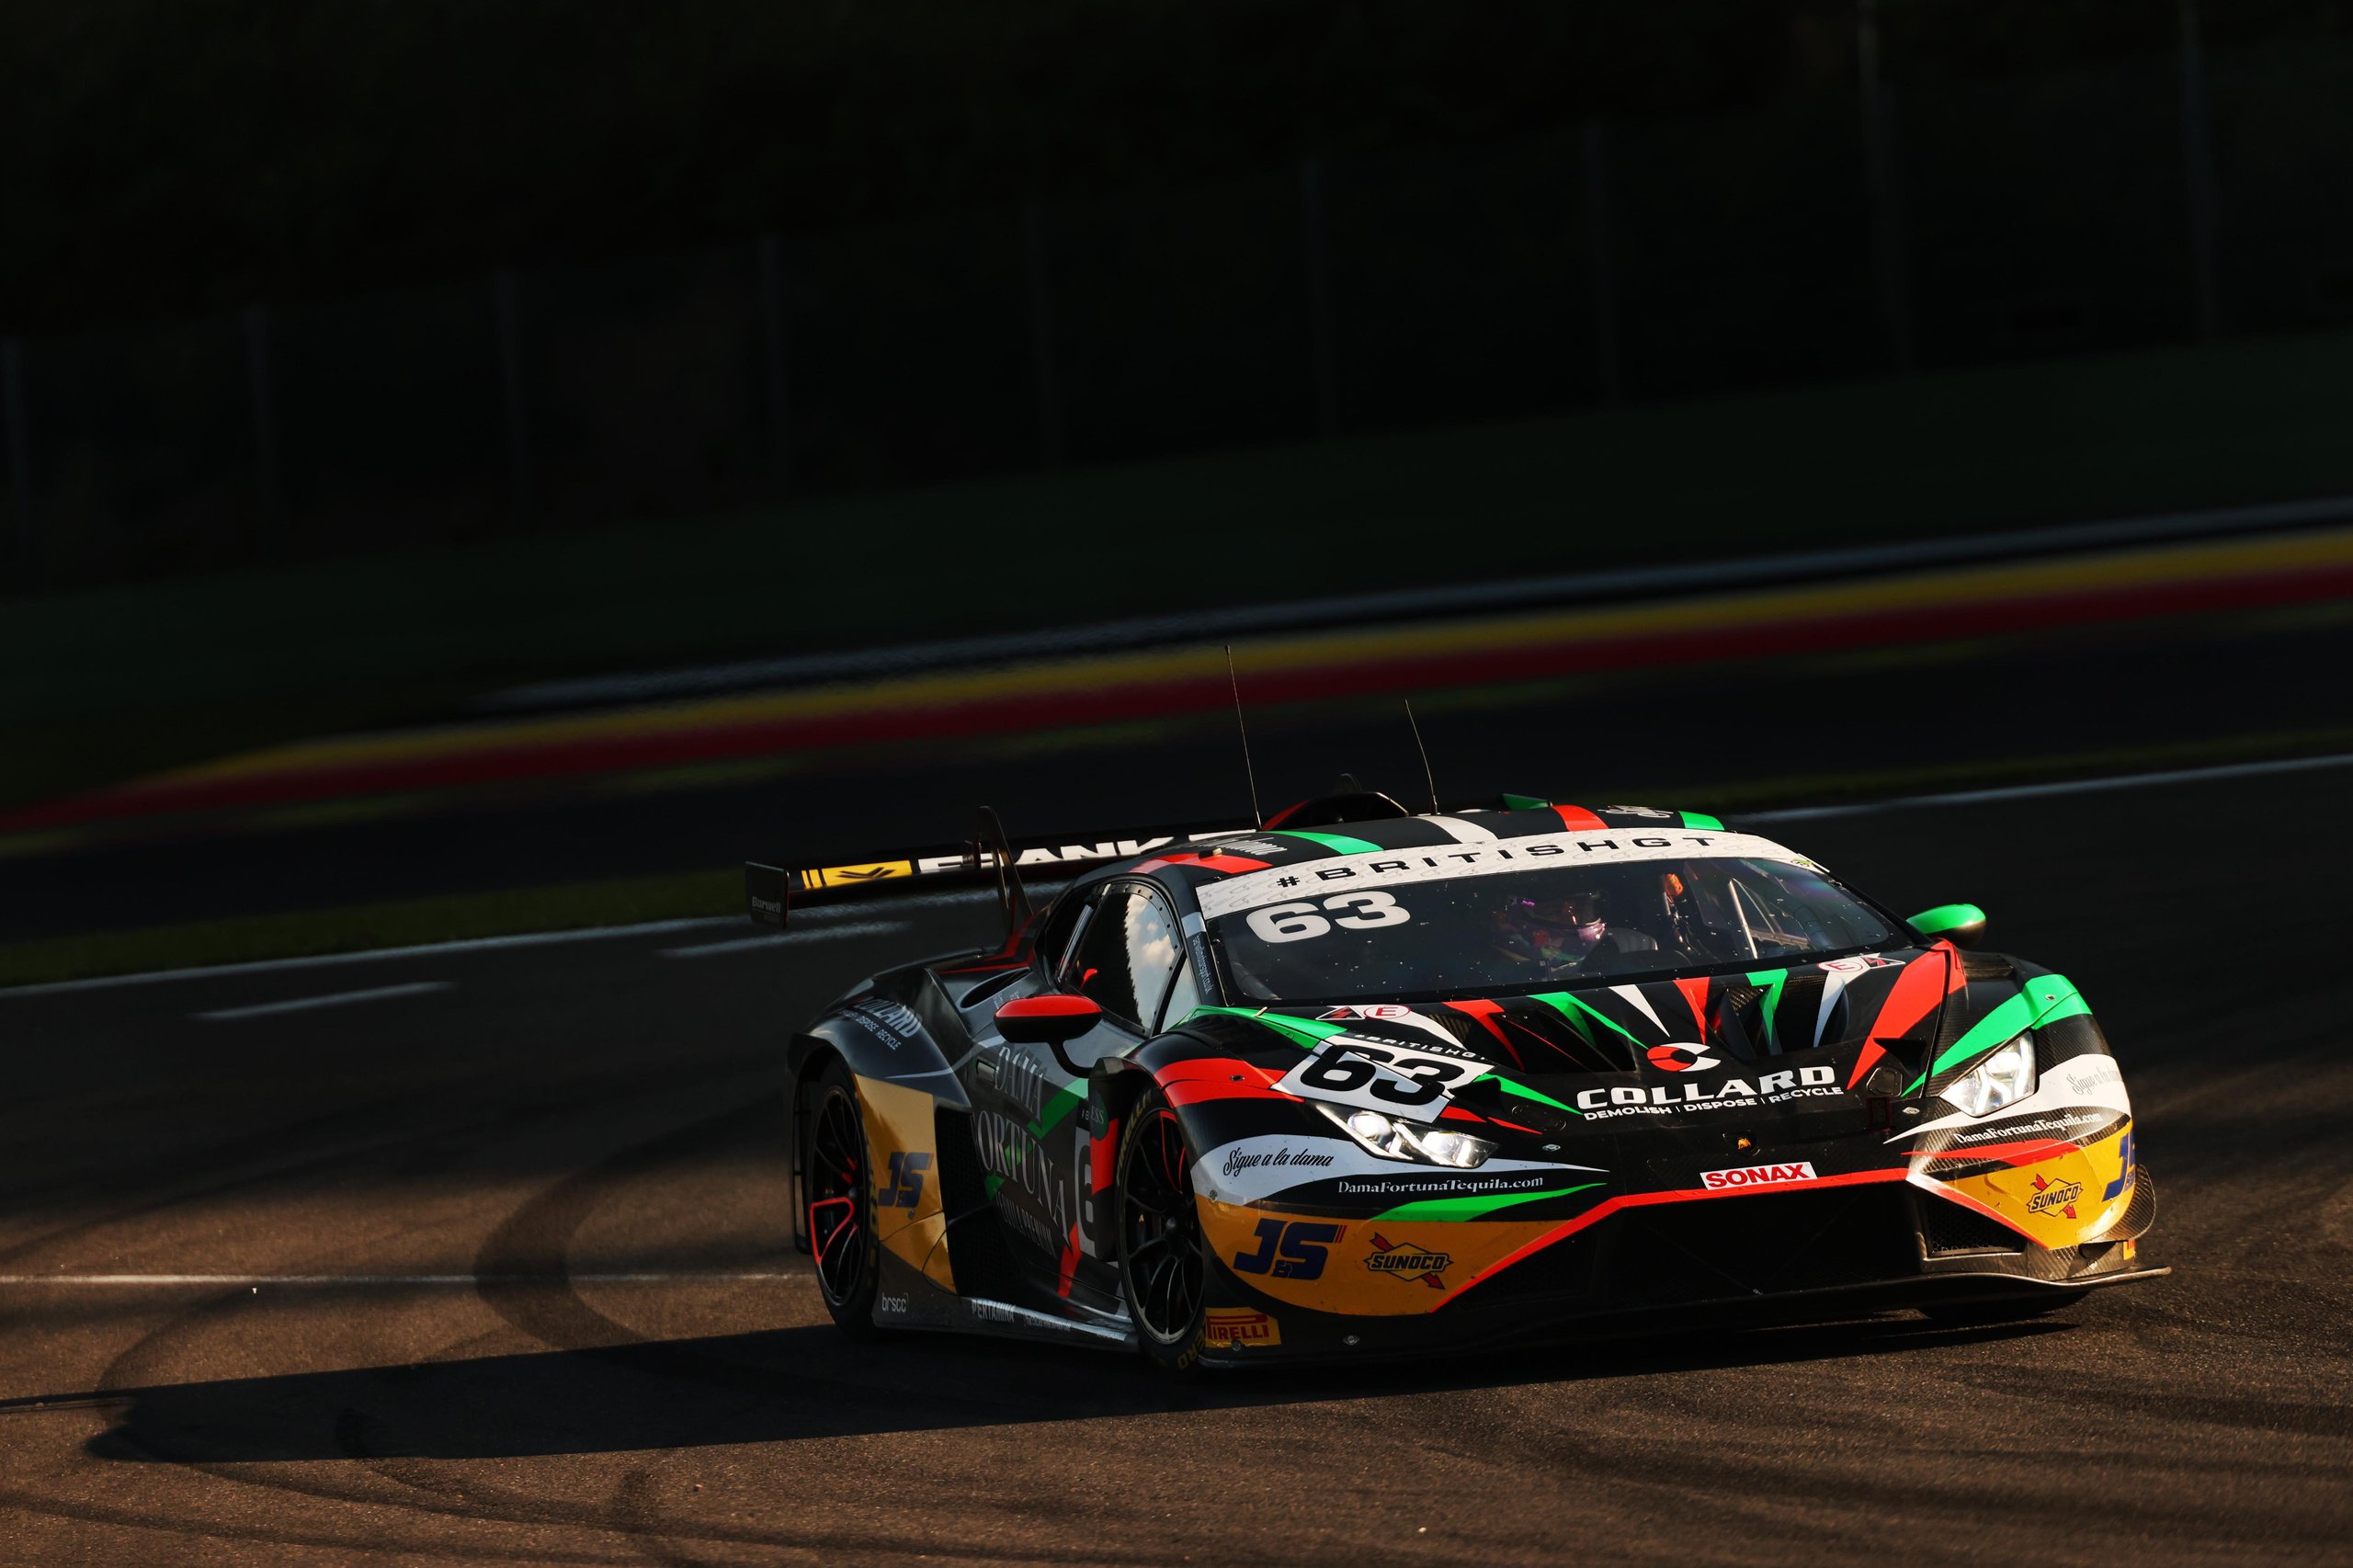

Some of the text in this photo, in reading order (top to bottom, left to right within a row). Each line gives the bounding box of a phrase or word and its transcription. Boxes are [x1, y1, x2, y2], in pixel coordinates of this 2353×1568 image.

[1276, 836, 1715, 888] #BRITISHGT
[1245, 891, 1411, 944] 63
[1300, 1044, 1465, 1106] 63
[1576, 1065, 1836, 1110] COLLARD
[1584, 1086, 1845, 1121] DEMOLISH DISPOSE RECYCLE
[1953, 1111, 2103, 1144] DamaFortunaTequila.com
[1272, 1148, 1290, 1166] la
[1291, 1148, 1335, 1167] dama
[878, 1152, 933, 1208] JS
[1338, 1176, 1544, 1194] DamaFortunaTequila.com
[1705, 1164, 1810, 1188] SONAX
[2029, 1184, 2081, 1211] SUNOCO
[1233, 1218, 1340, 1280] JS
[1373, 1254, 1446, 1270] SUNOCO
[1206, 1313, 1270, 1340] PIRELLI
